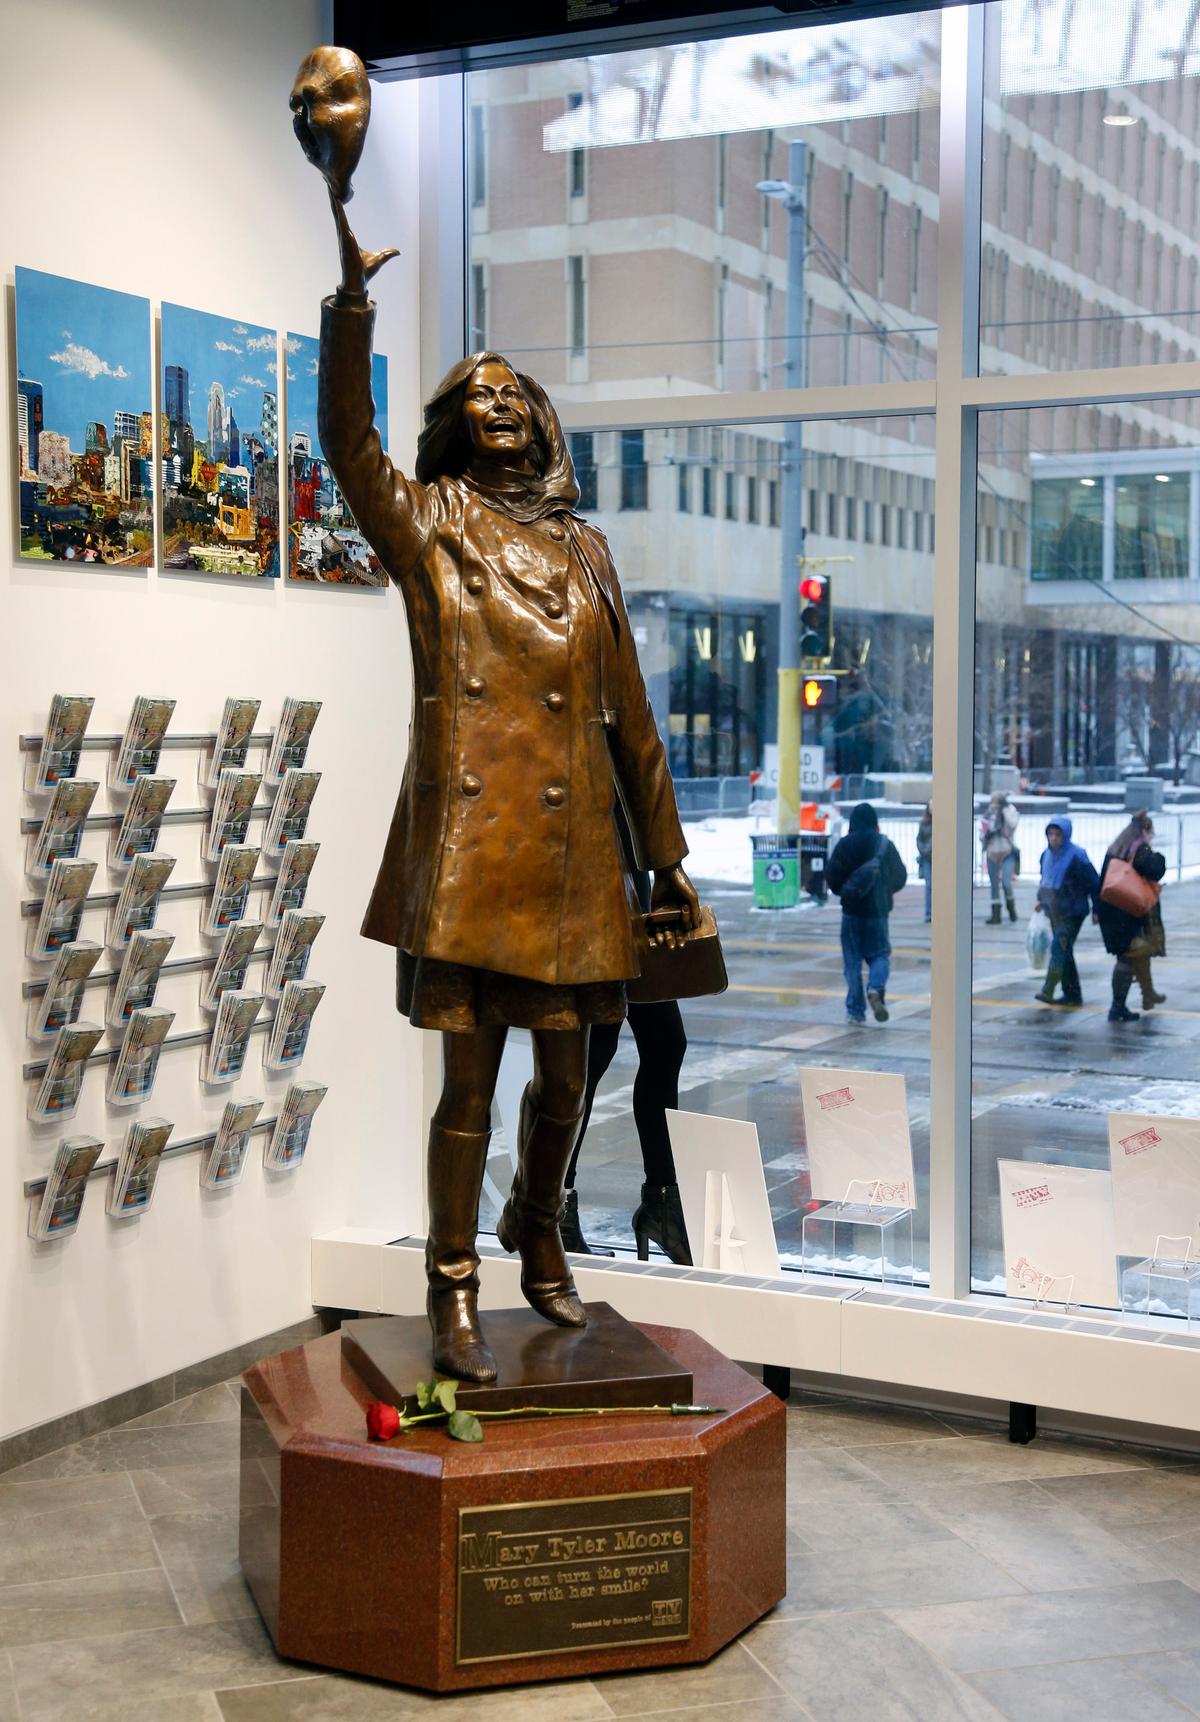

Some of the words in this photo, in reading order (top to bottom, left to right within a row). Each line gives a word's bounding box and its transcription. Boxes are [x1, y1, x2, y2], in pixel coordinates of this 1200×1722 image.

[770, 769, 819, 785] CED
[461, 1531, 539, 1569] Mary
[548, 1536, 607, 1560] Tyler
[614, 1530, 684, 1551] Moore
[484, 1577, 519, 1591] Who
[524, 1575, 550, 1588] can
[557, 1571, 591, 1584] turn
[597, 1566, 621, 1579] the
[625, 1560, 669, 1577] world
[504, 1594, 523, 1606] on
[529, 1587, 564, 1602] with
[569, 1586, 595, 1599] her
[600, 1578, 649, 1596] smile?
[654, 1601, 681, 1616] TV
